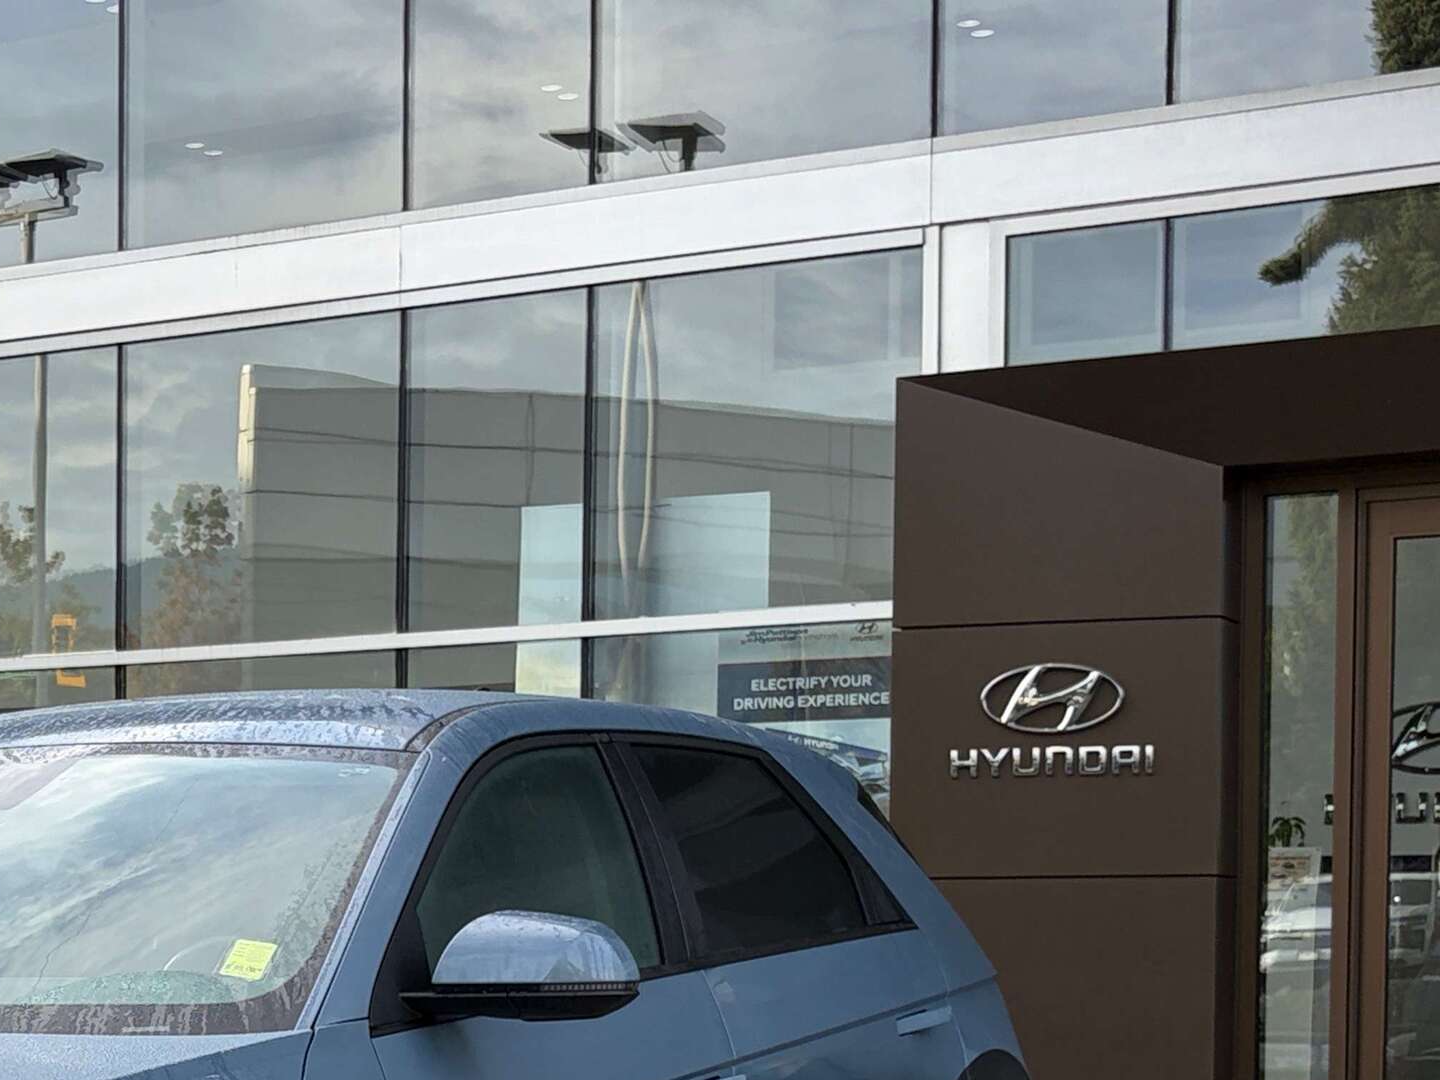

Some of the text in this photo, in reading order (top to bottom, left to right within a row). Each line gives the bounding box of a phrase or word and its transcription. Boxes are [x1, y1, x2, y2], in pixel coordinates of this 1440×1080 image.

[751, 674, 873, 692] ELECTRIFY YOUR
[733, 692, 891, 711] DRIVING EXPERIENCE
[949, 744, 1155, 778] HYUNDAI
